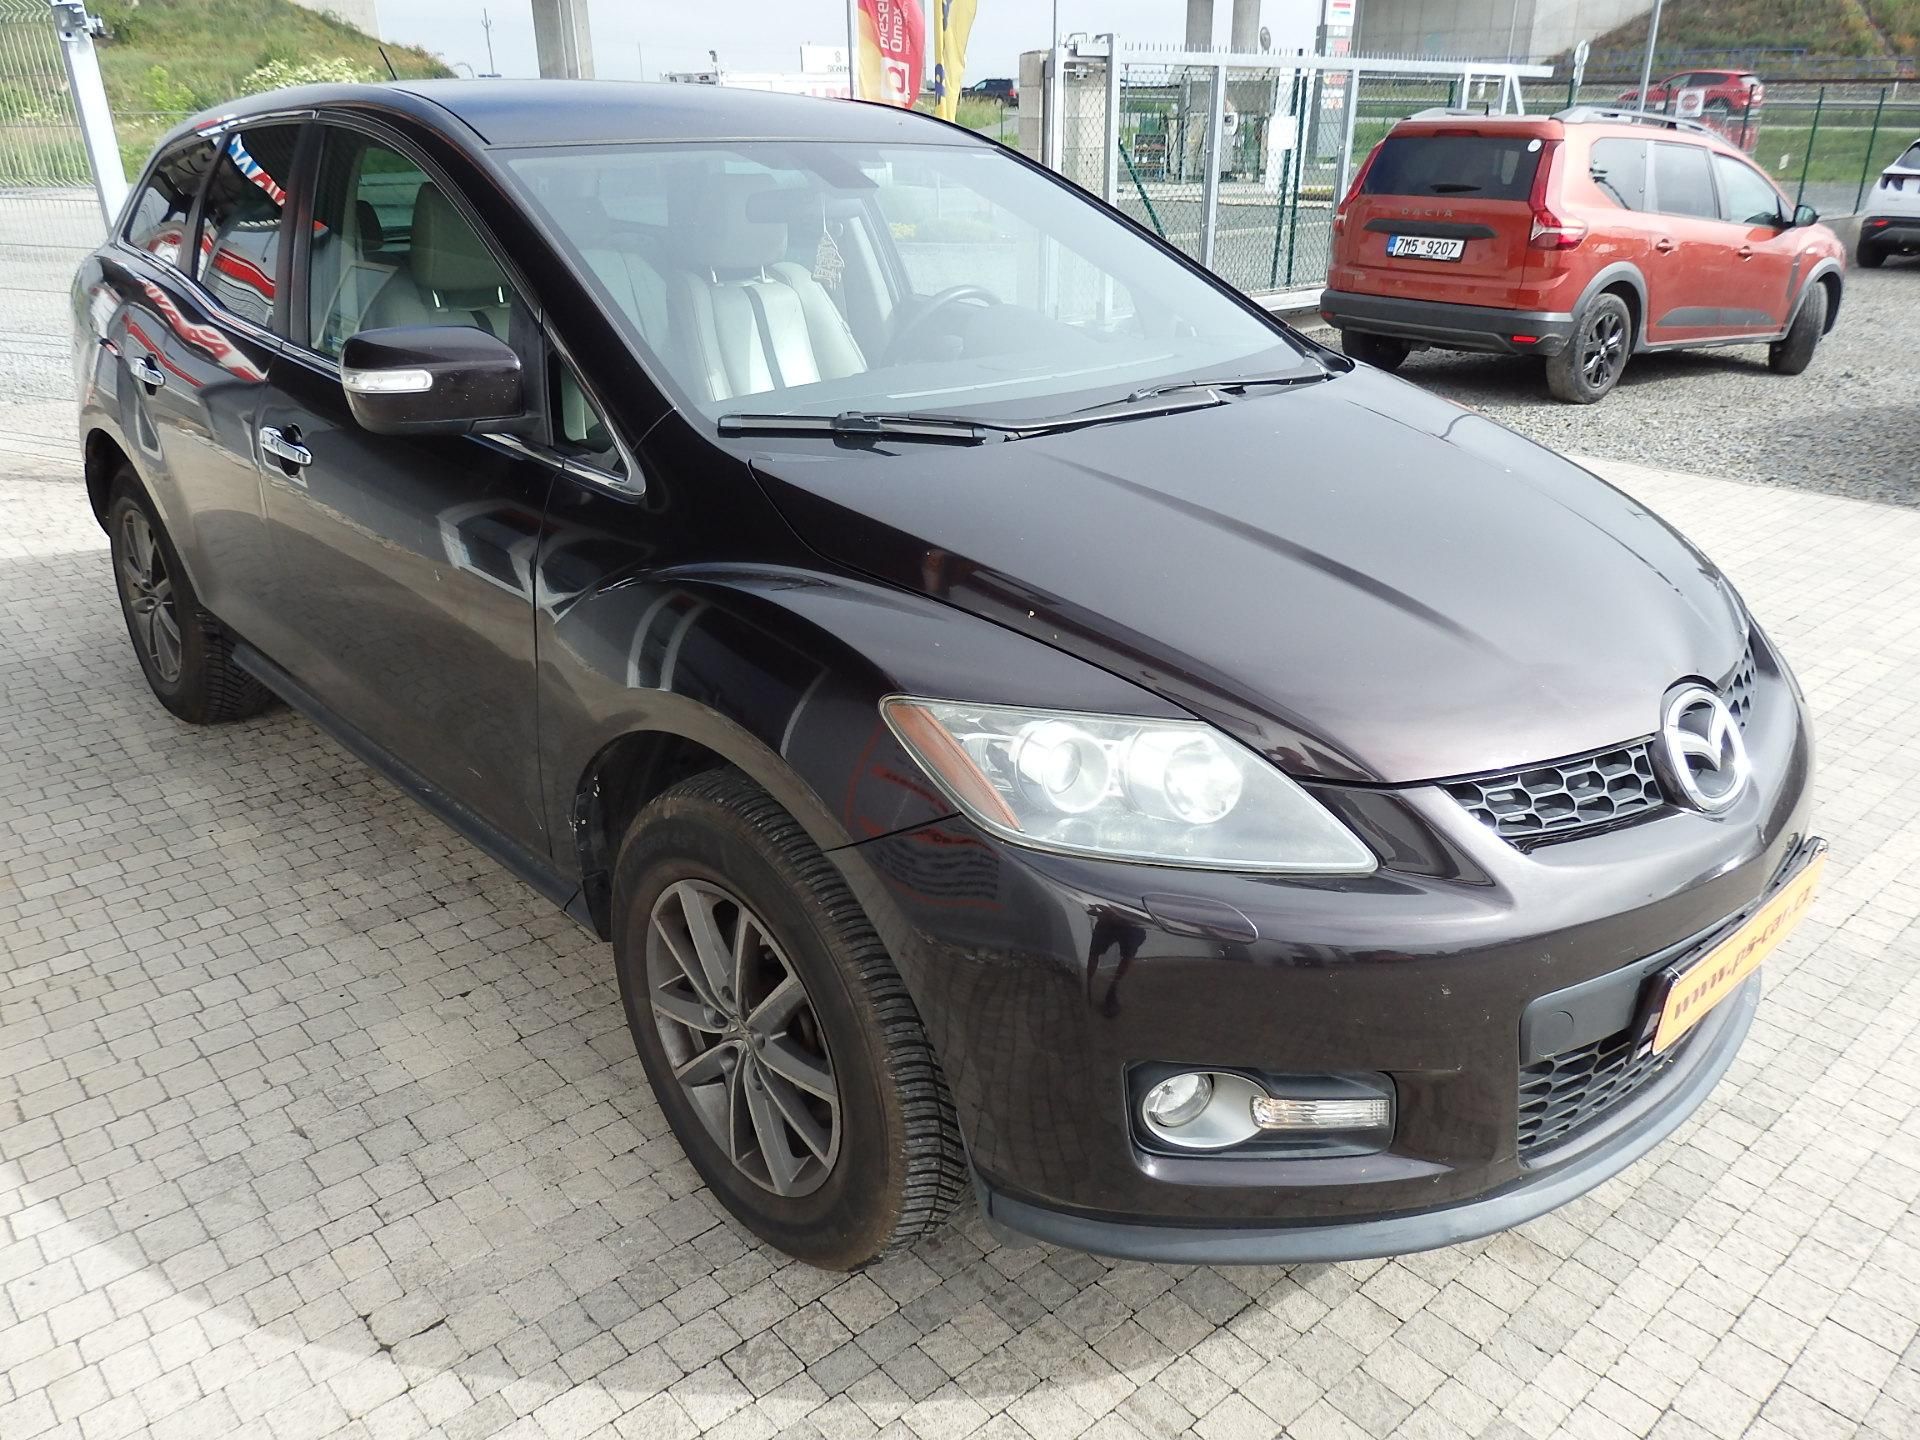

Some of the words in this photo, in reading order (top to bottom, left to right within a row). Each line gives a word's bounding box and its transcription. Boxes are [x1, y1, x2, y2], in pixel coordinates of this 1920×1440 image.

[890, 7, 903, 53] Qmax
[1402, 208, 1454, 217] DACIA
[1396, 238, 1419, 253] 7M5
[1426, 241, 1457, 255] 9207
